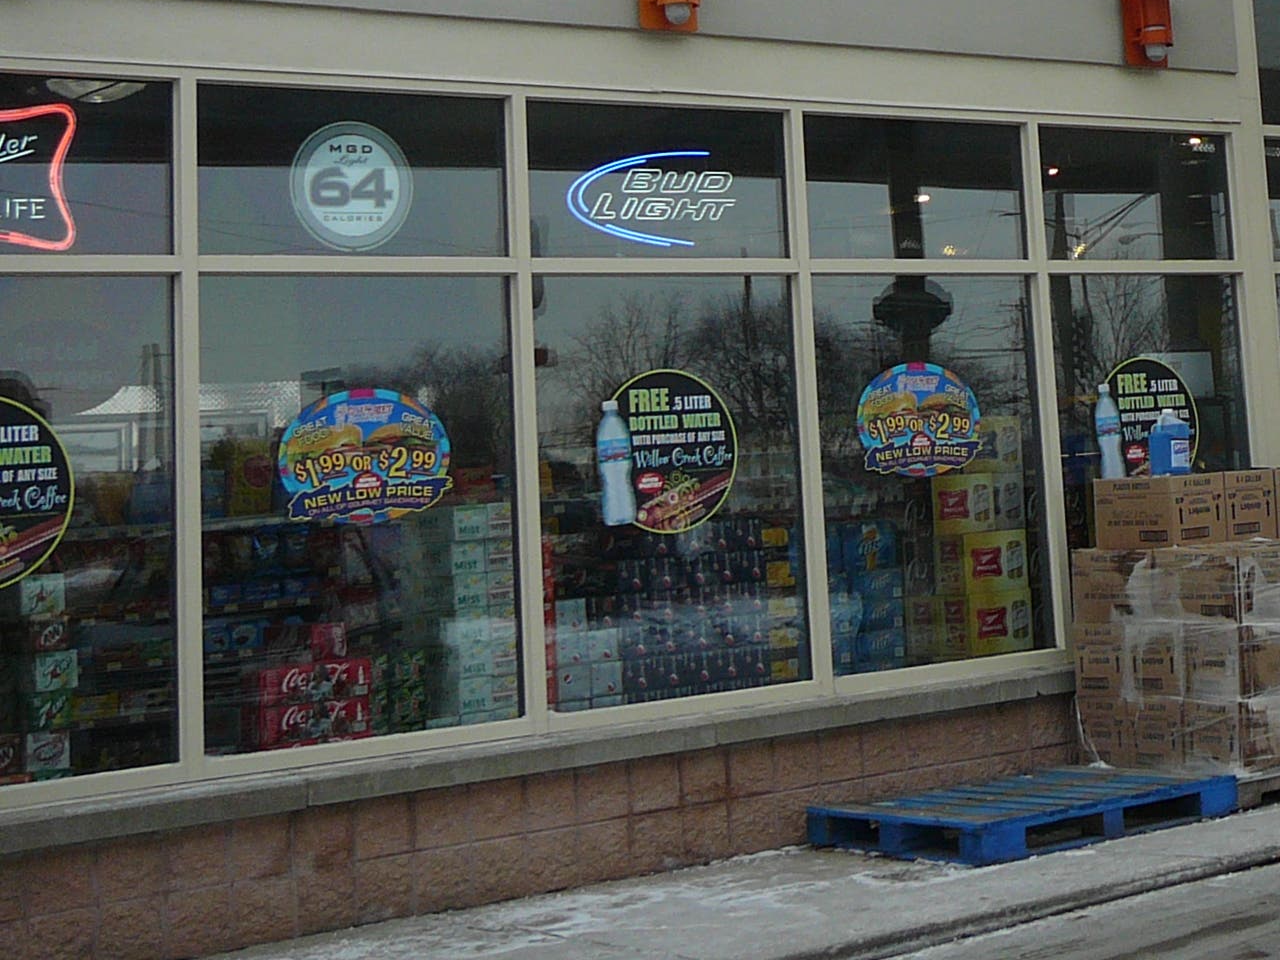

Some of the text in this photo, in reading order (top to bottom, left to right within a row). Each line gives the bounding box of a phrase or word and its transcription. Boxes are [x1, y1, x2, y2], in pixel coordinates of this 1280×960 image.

[310, 166, 394, 209] 64
[621, 168, 733, 193] BUD
[0, 198, 46, 219] IFE
[590, 192, 737, 221] LIGHT
[1117, 372, 1148, 394] FREE
[1157, 378, 1179, 392] LITER
[628, 387, 670, 413] FREE
[683, 394, 711, 410] LITER
[1118, 393, 1186, 410] BOTTLED WATER
[629, 412, 721, 431] BOTTLED WATER
[910, 418, 923, 432] OR
[0, 424, 39, 443] LITER
[352, 455, 373, 471] OR
[702, 444, 733, 466] Coffee
[876, 445, 968, 461] NEW LOW PRICE
[18, 468, 36, 482] ANY
[37, 467, 58, 481] SIZE
[25, 484, 67, 511] Coffee
[304, 485, 434, 510] NEW LOW PRICE
